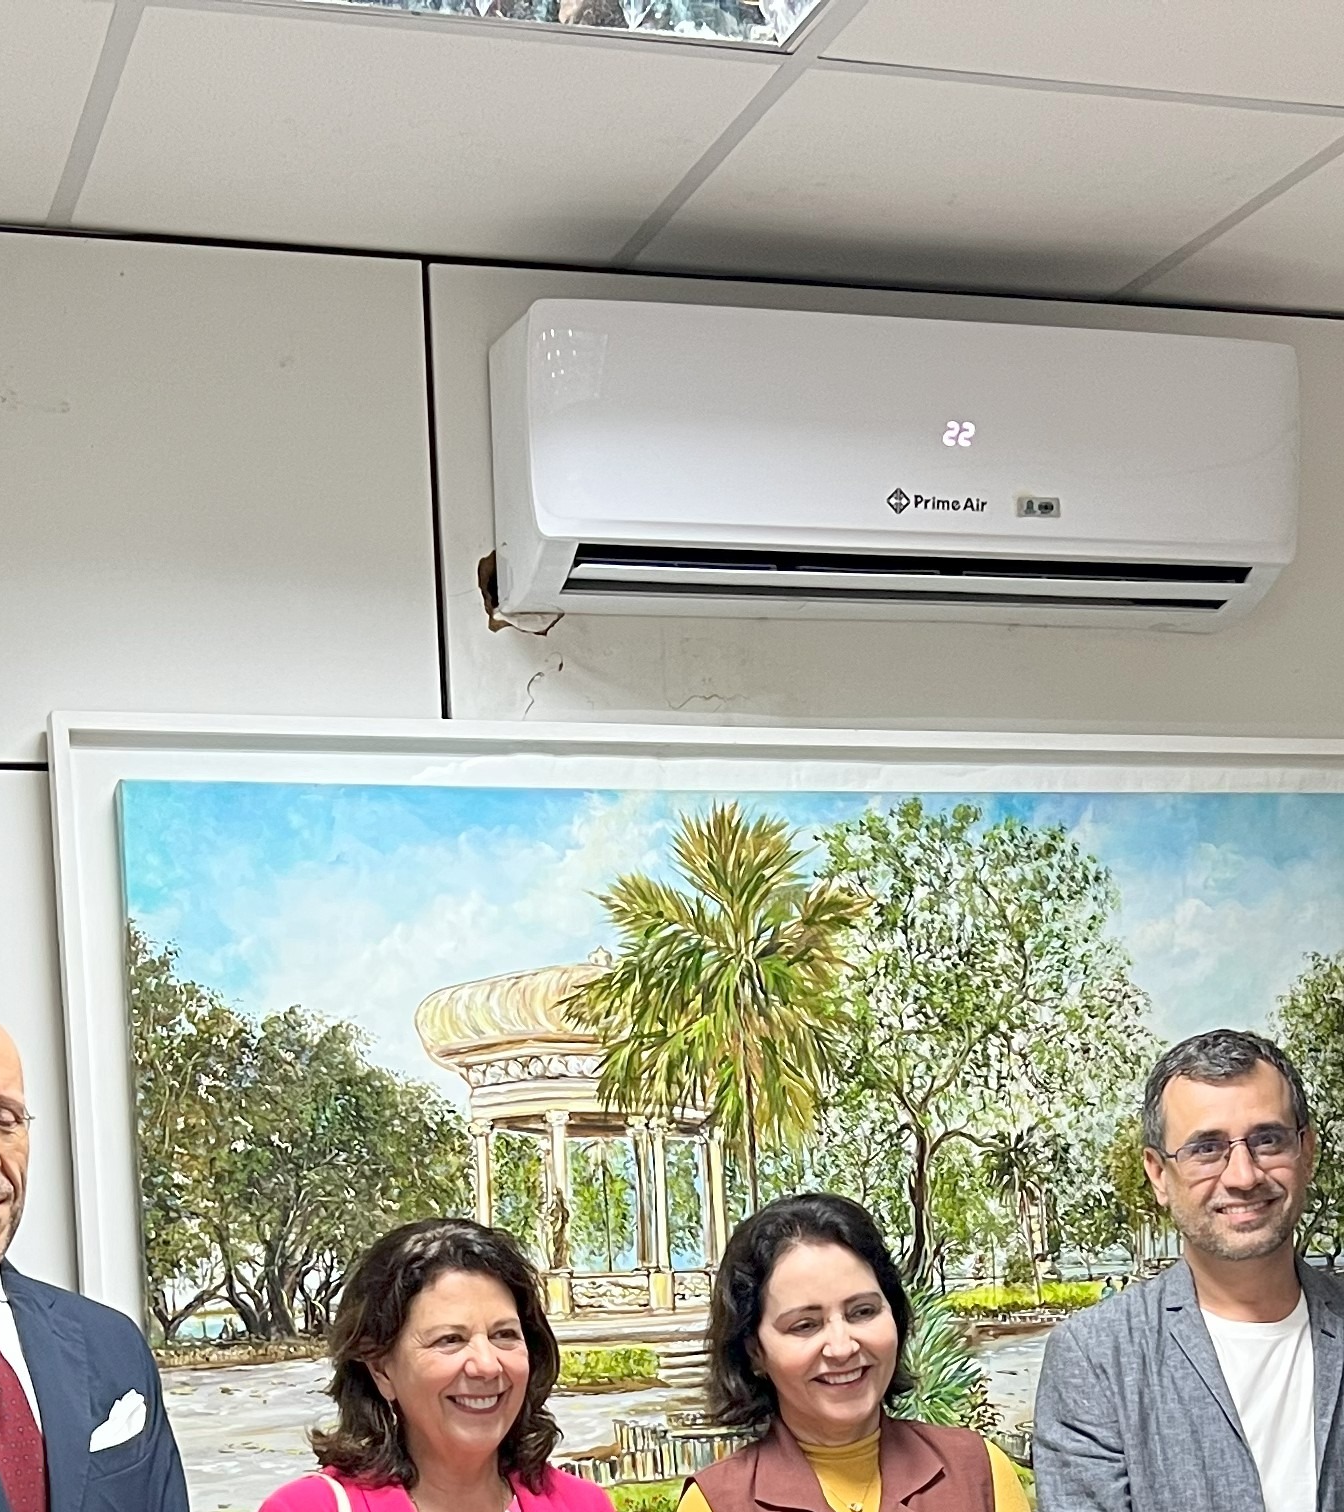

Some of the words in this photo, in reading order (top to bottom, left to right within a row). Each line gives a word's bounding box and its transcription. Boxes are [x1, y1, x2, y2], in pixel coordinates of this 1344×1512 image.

[942, 420, 976, 447] 22
[914, 494, 961, 511] Prime
[963, 497, 988, 512] Air
